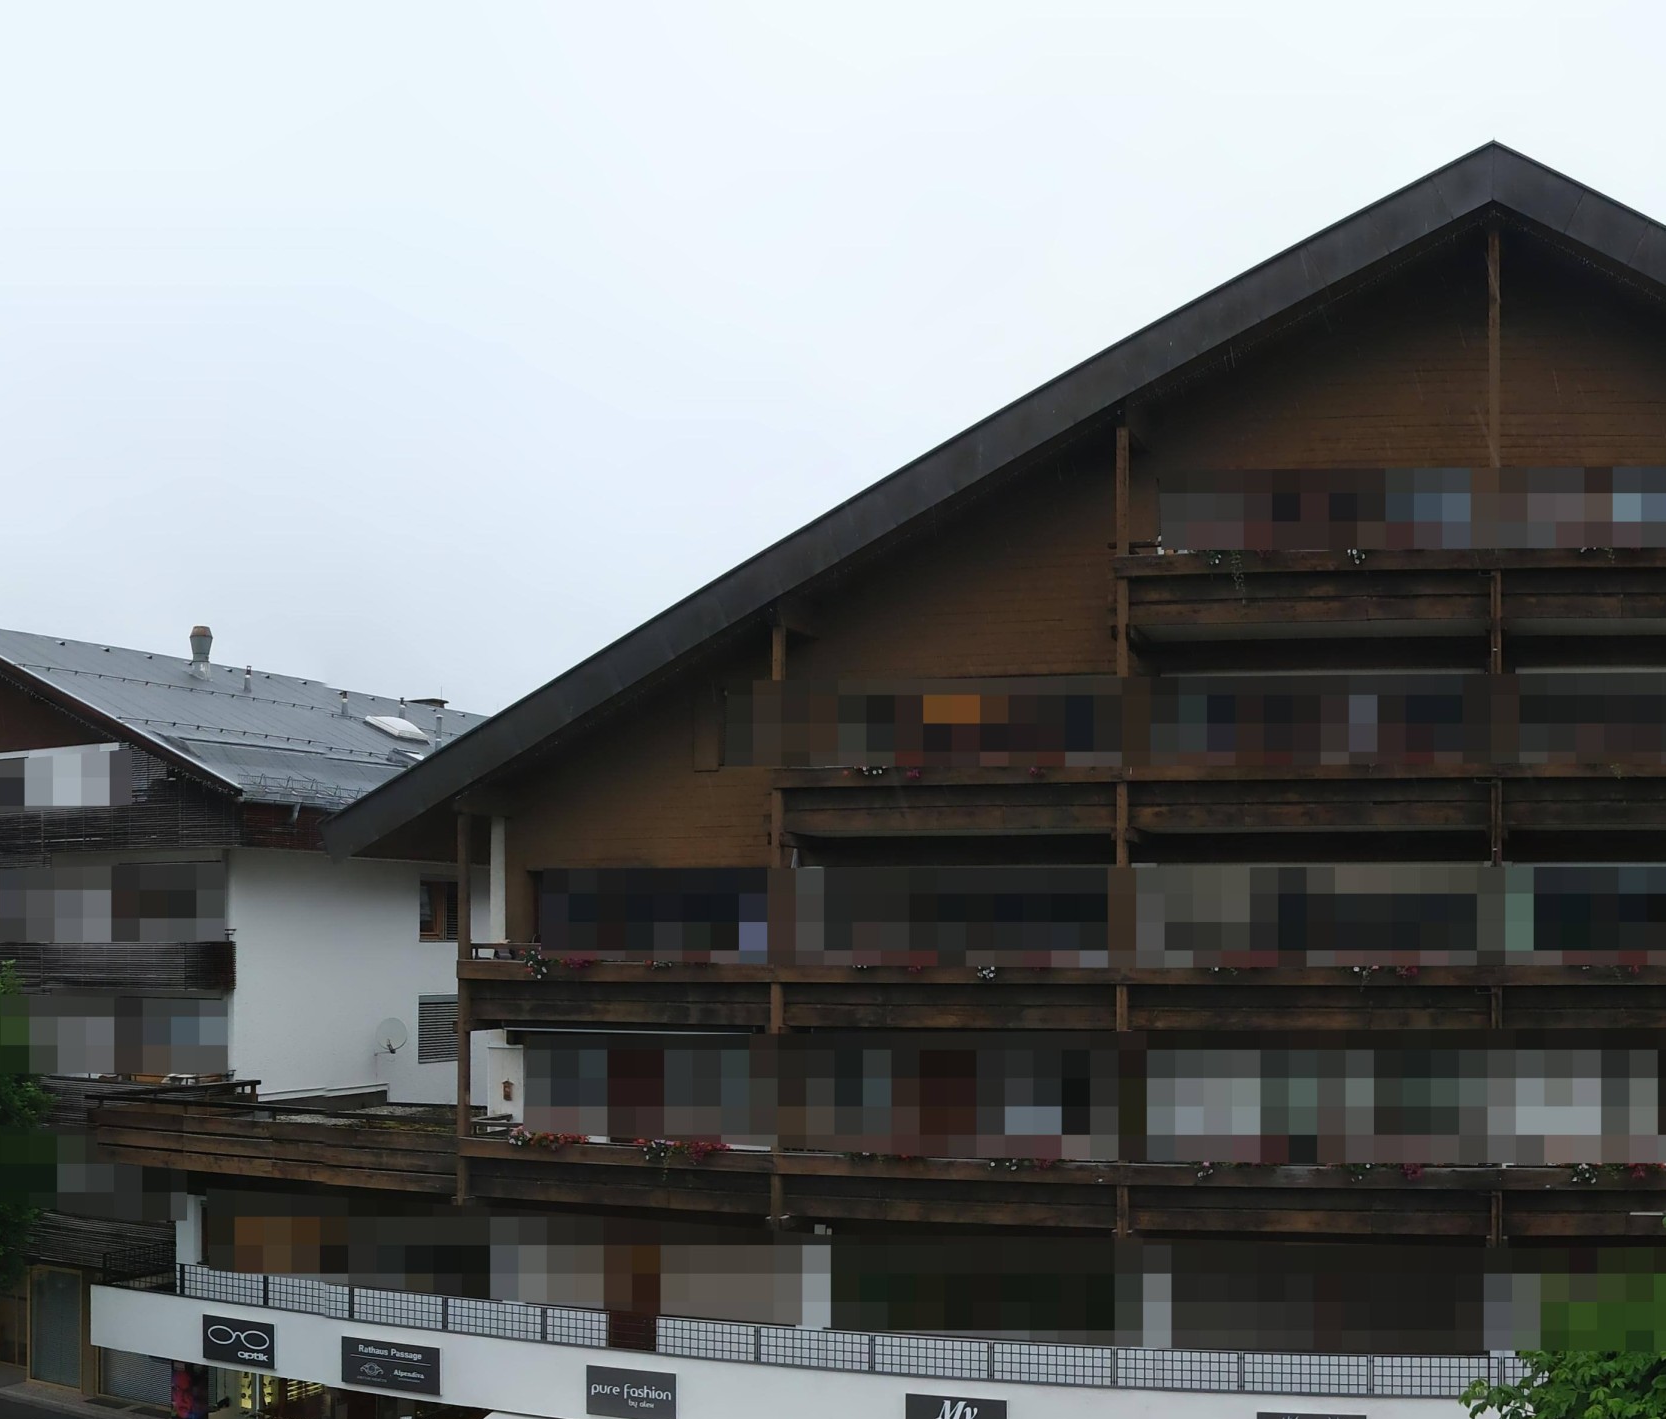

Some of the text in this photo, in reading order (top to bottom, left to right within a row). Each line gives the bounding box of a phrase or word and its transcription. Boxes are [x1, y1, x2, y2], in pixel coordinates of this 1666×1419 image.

[237, 1350, 269, 1361] optik
[358, 1344, 422, 1361] Rathaus Passage
[591, 1383, 672, 1401] pure fashion
